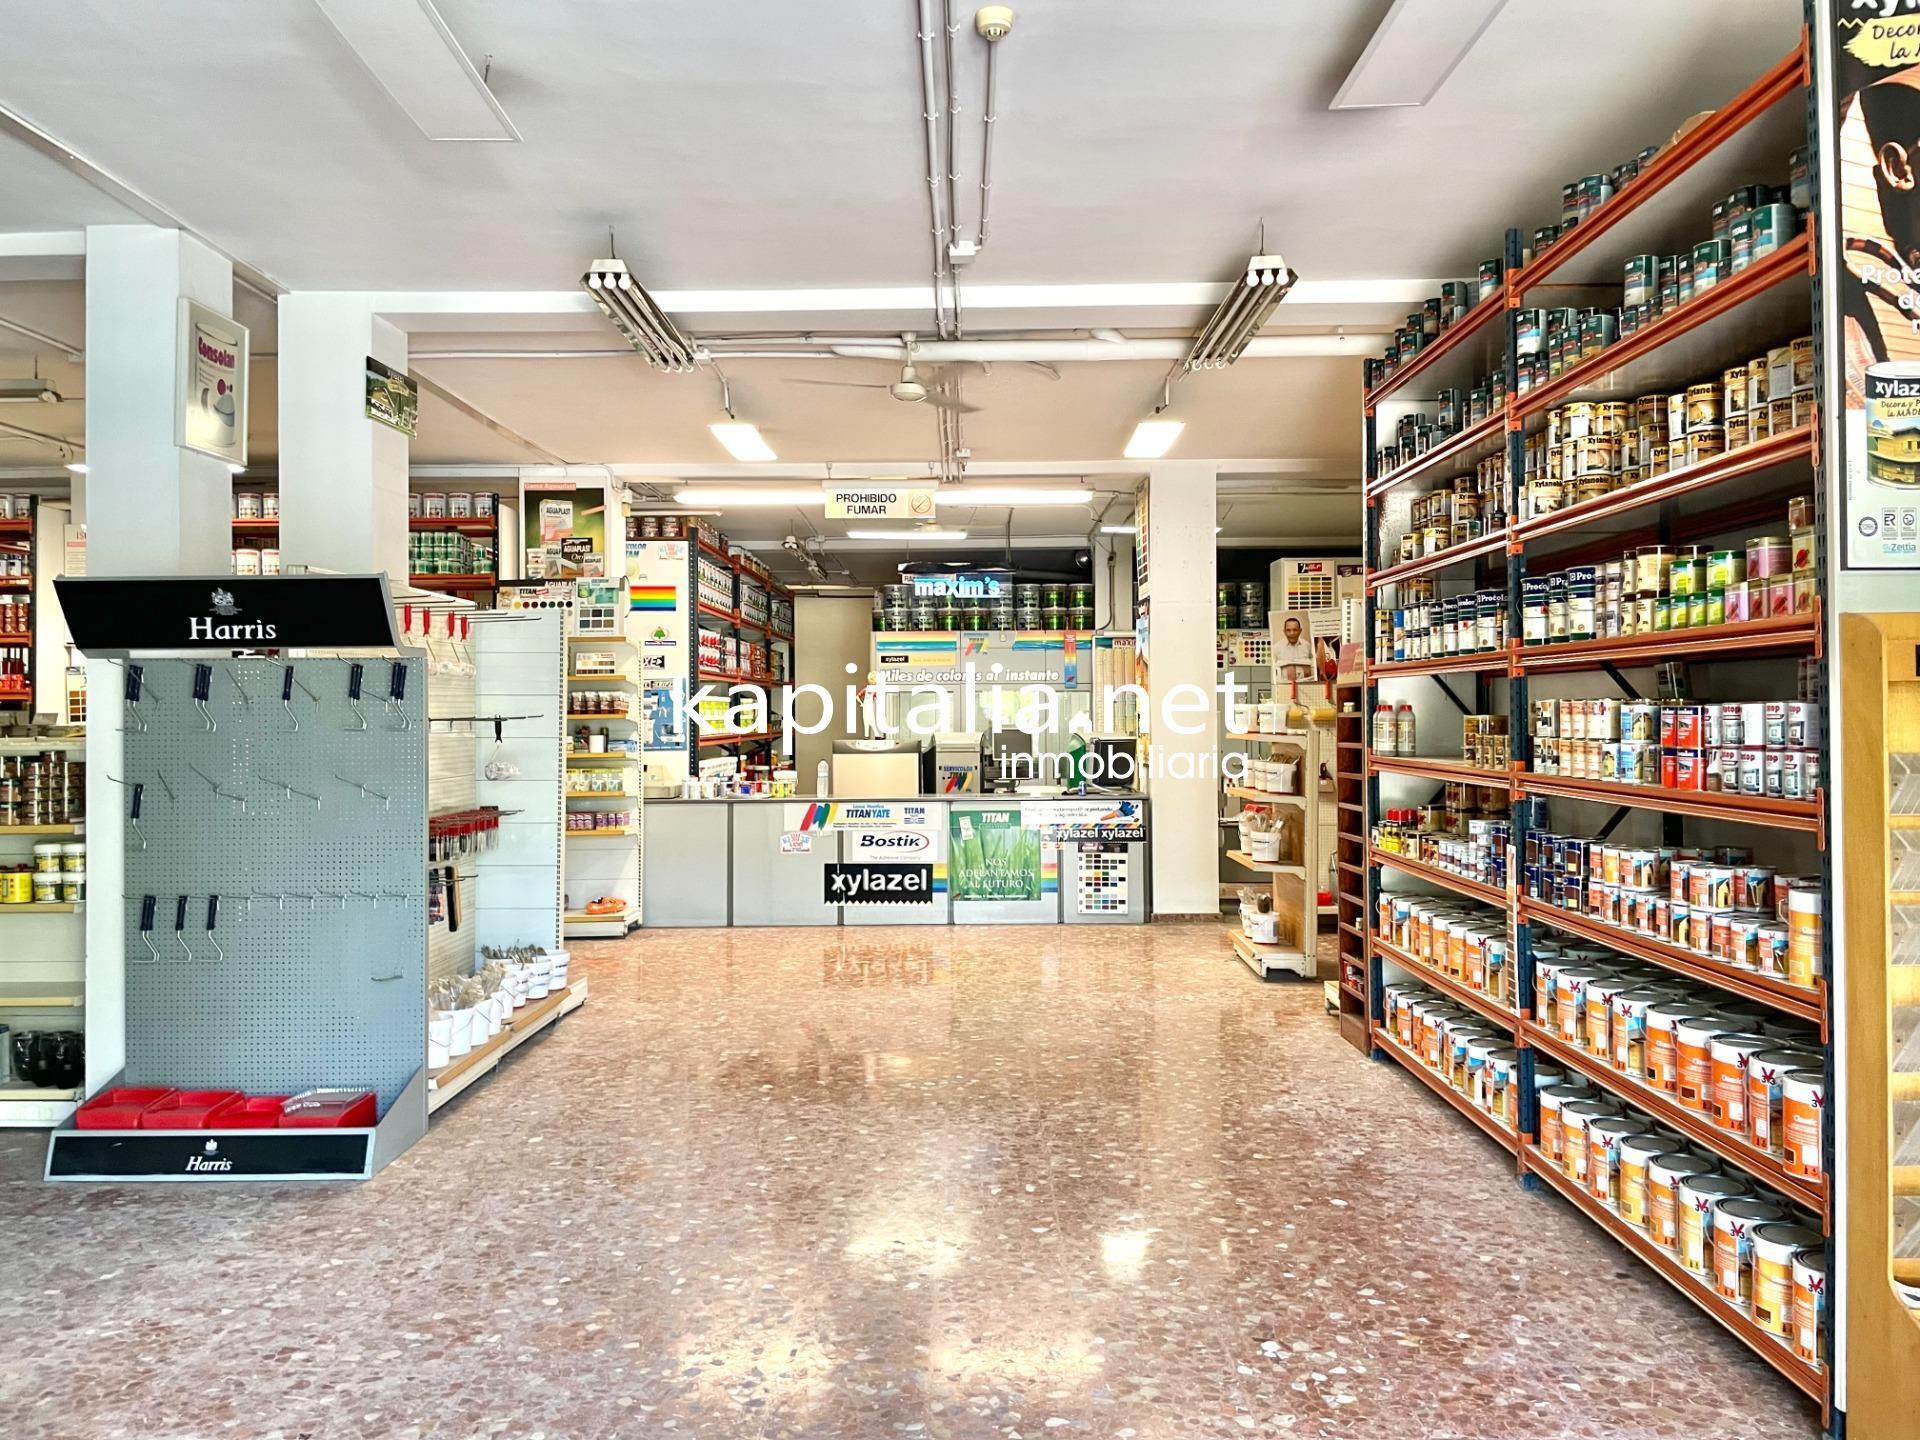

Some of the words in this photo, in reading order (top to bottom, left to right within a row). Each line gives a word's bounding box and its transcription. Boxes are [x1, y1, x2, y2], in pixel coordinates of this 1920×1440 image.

[836, 493, 897, 503] PROHIBIDO
[846, 505, 887, 514] FUMAR
[914, 576, 1000, 597] maxim's
[189, 617, 276, 640] Harris
[916, 668, 933, 682] de
[937, 668, 986, 682] colors
[1005, 668, 1060, 682] instante
[981, 812, 1010, 823] TITAN
[1056, 827, 1099, 840] xylazel
[1101, 827, 1144, 840] xylazel
[860, 834, 921, 847] Bostik
[985, 858, 1007, 866] NOS
[959, 869, 1034, 878] ADELANTAMOS
[831, 868, 927, 896] xylazel
[968, 880, 981, 888] AL
[983, 880, 1024, 889] FUTURO
[185, 1156, 232, 1171] Harris
